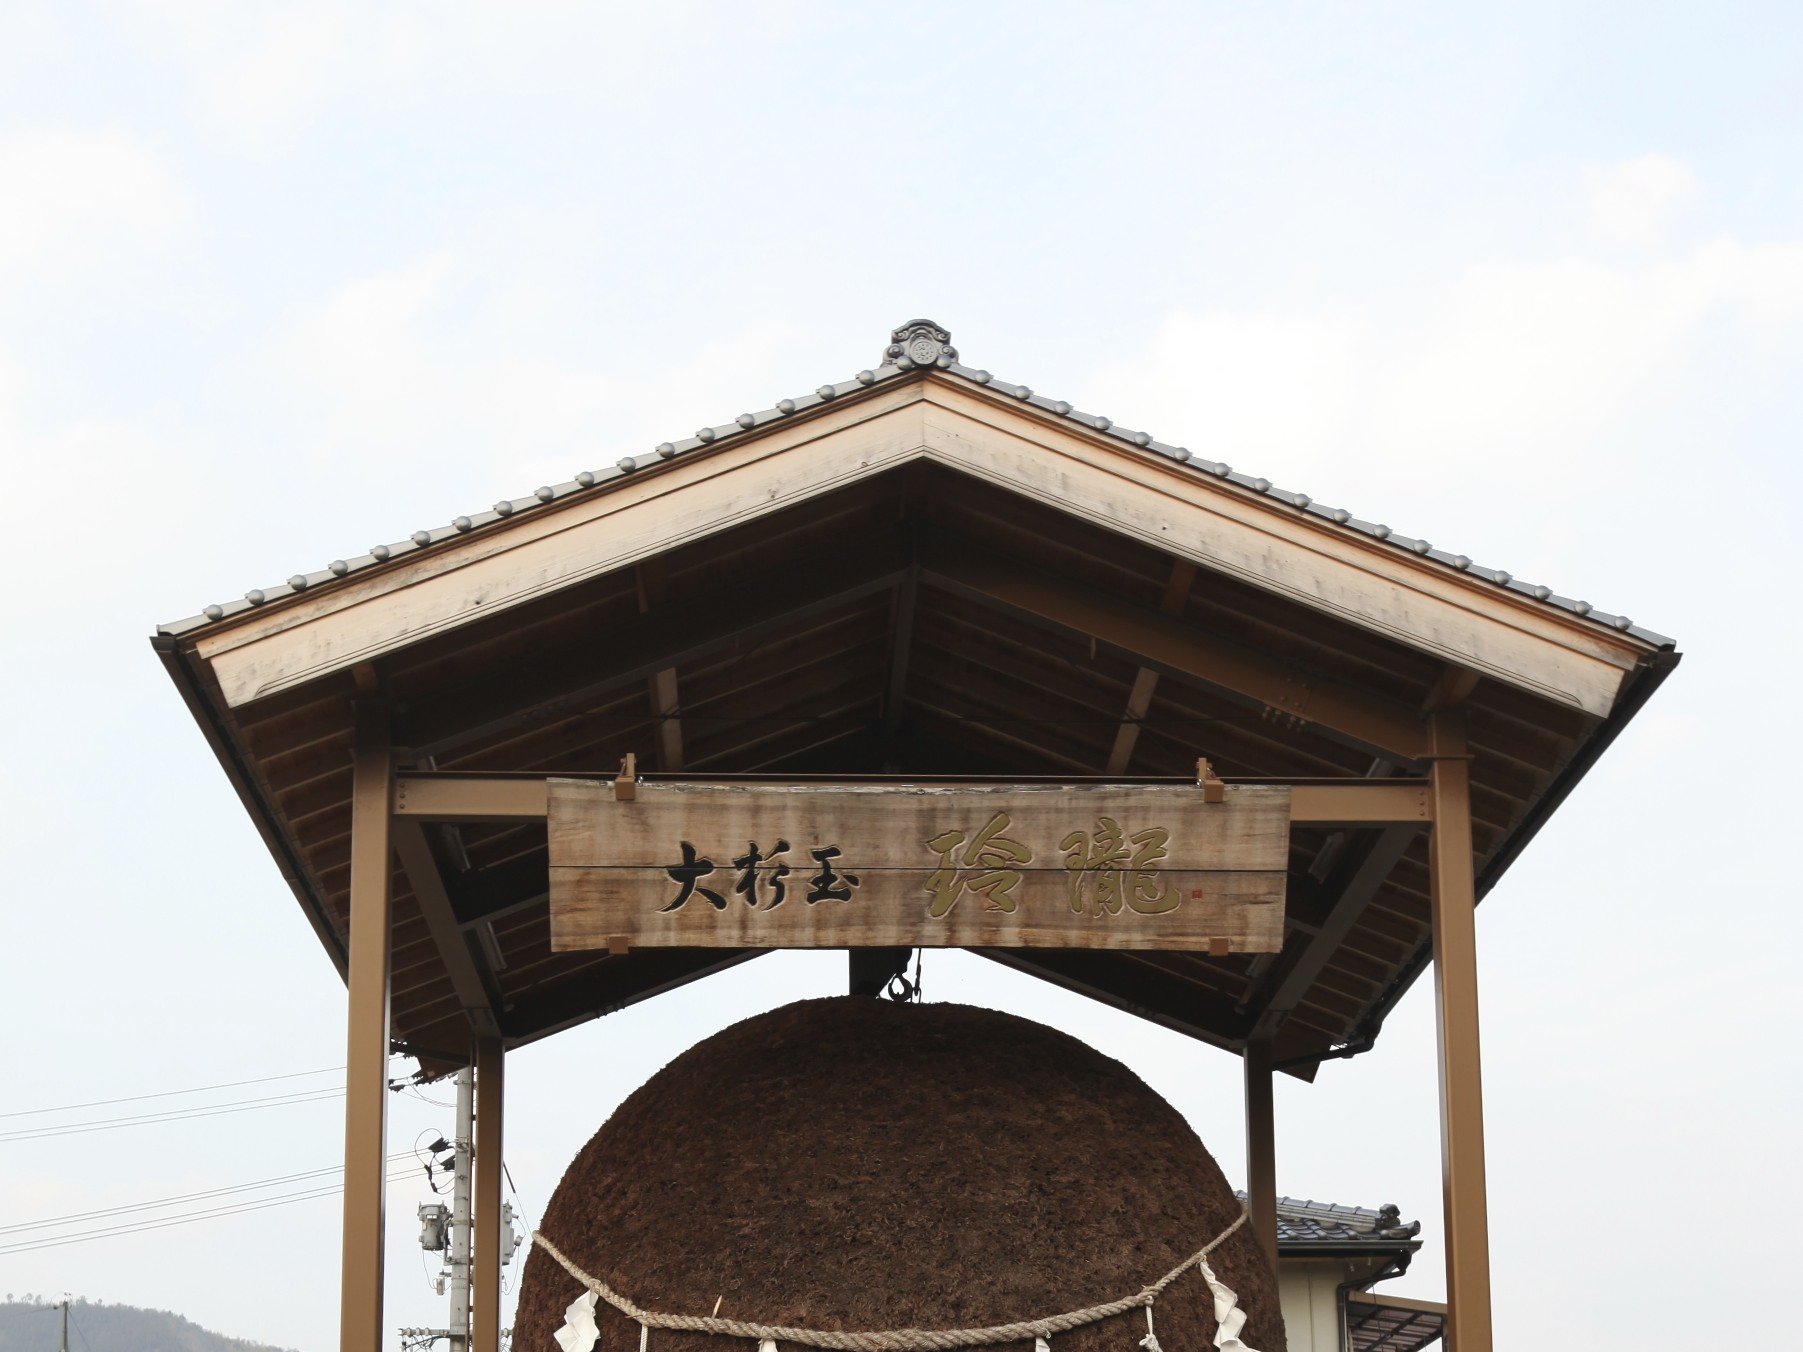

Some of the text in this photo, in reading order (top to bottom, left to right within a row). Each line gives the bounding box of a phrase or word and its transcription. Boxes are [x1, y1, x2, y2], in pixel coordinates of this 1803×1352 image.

[656, 812, 1183, 918] 大杉玉 玲瓏
